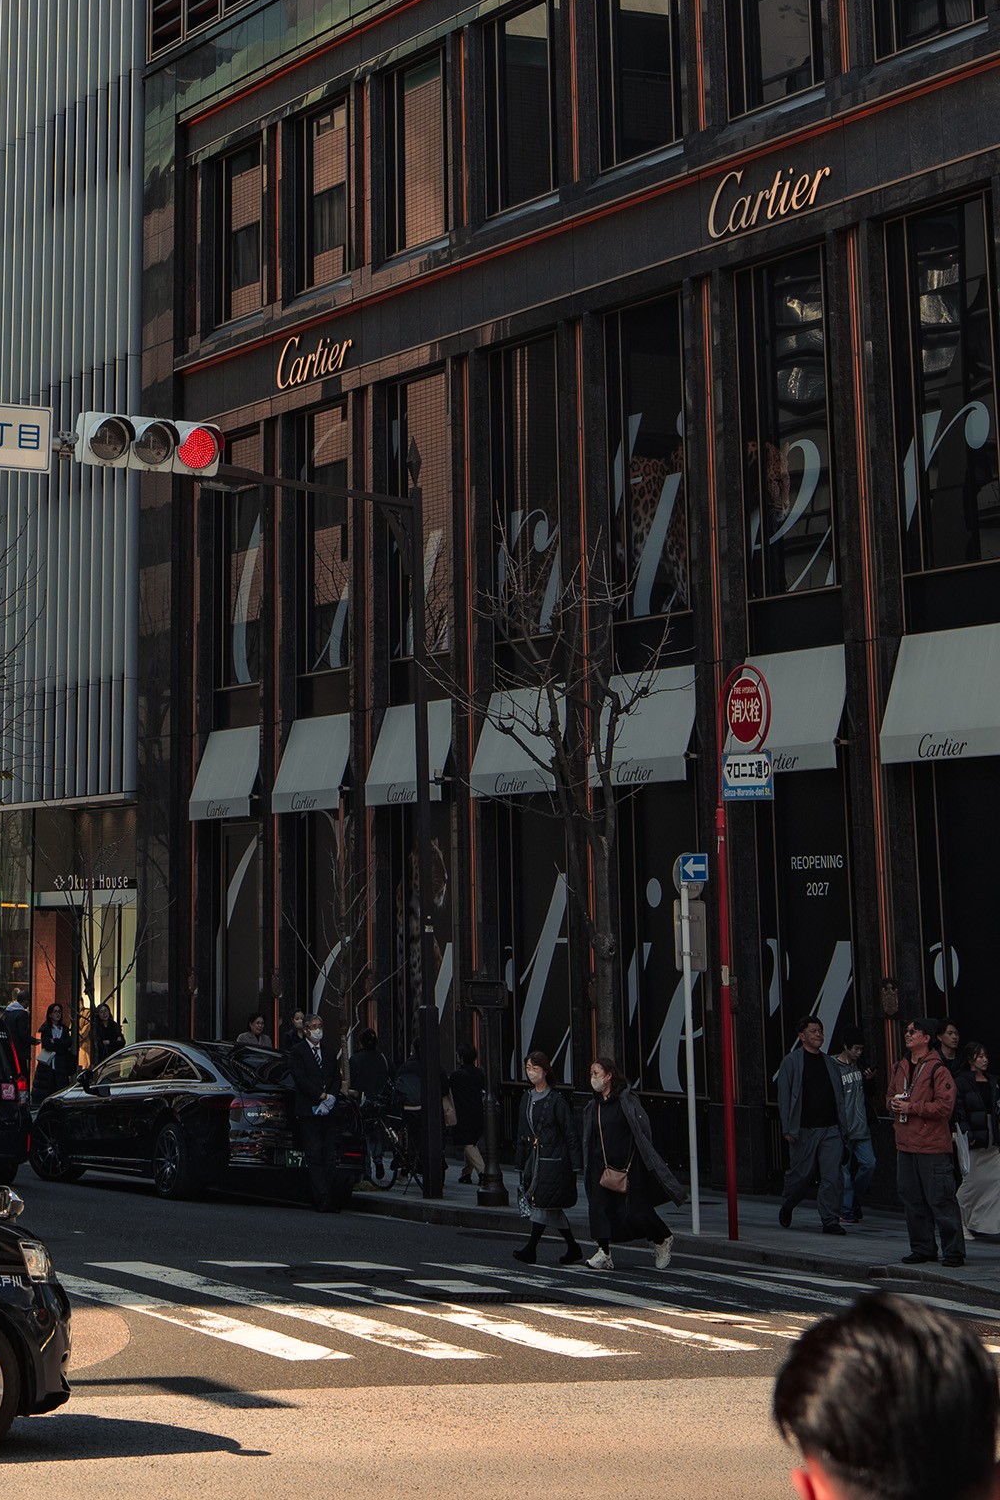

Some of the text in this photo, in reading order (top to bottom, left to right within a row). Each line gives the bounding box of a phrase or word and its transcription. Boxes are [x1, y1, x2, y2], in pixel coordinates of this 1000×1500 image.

[708, 166, 831, 239] Cartier
[277, 336, 353, 390] Cartier
[731, 697, 761, 723] 消火栓
[918, 733, 967, 758] Cartier
[726, 760, 769, 779] マロニエ通り
[773, 753, 799, 770] rtier
[616, 762, 654, 783] Cartier
[494, 773, 528, 794] Cartier
[291, 792, 317, 810] Cartier
[386, 784, 416, 803] Cartier
[206, 799, 230, 817] Cartier
[791, 855, 844, 870] REOPENING
[99, 874, 129, 889] House
[806, 882, 830, 896] 2027
